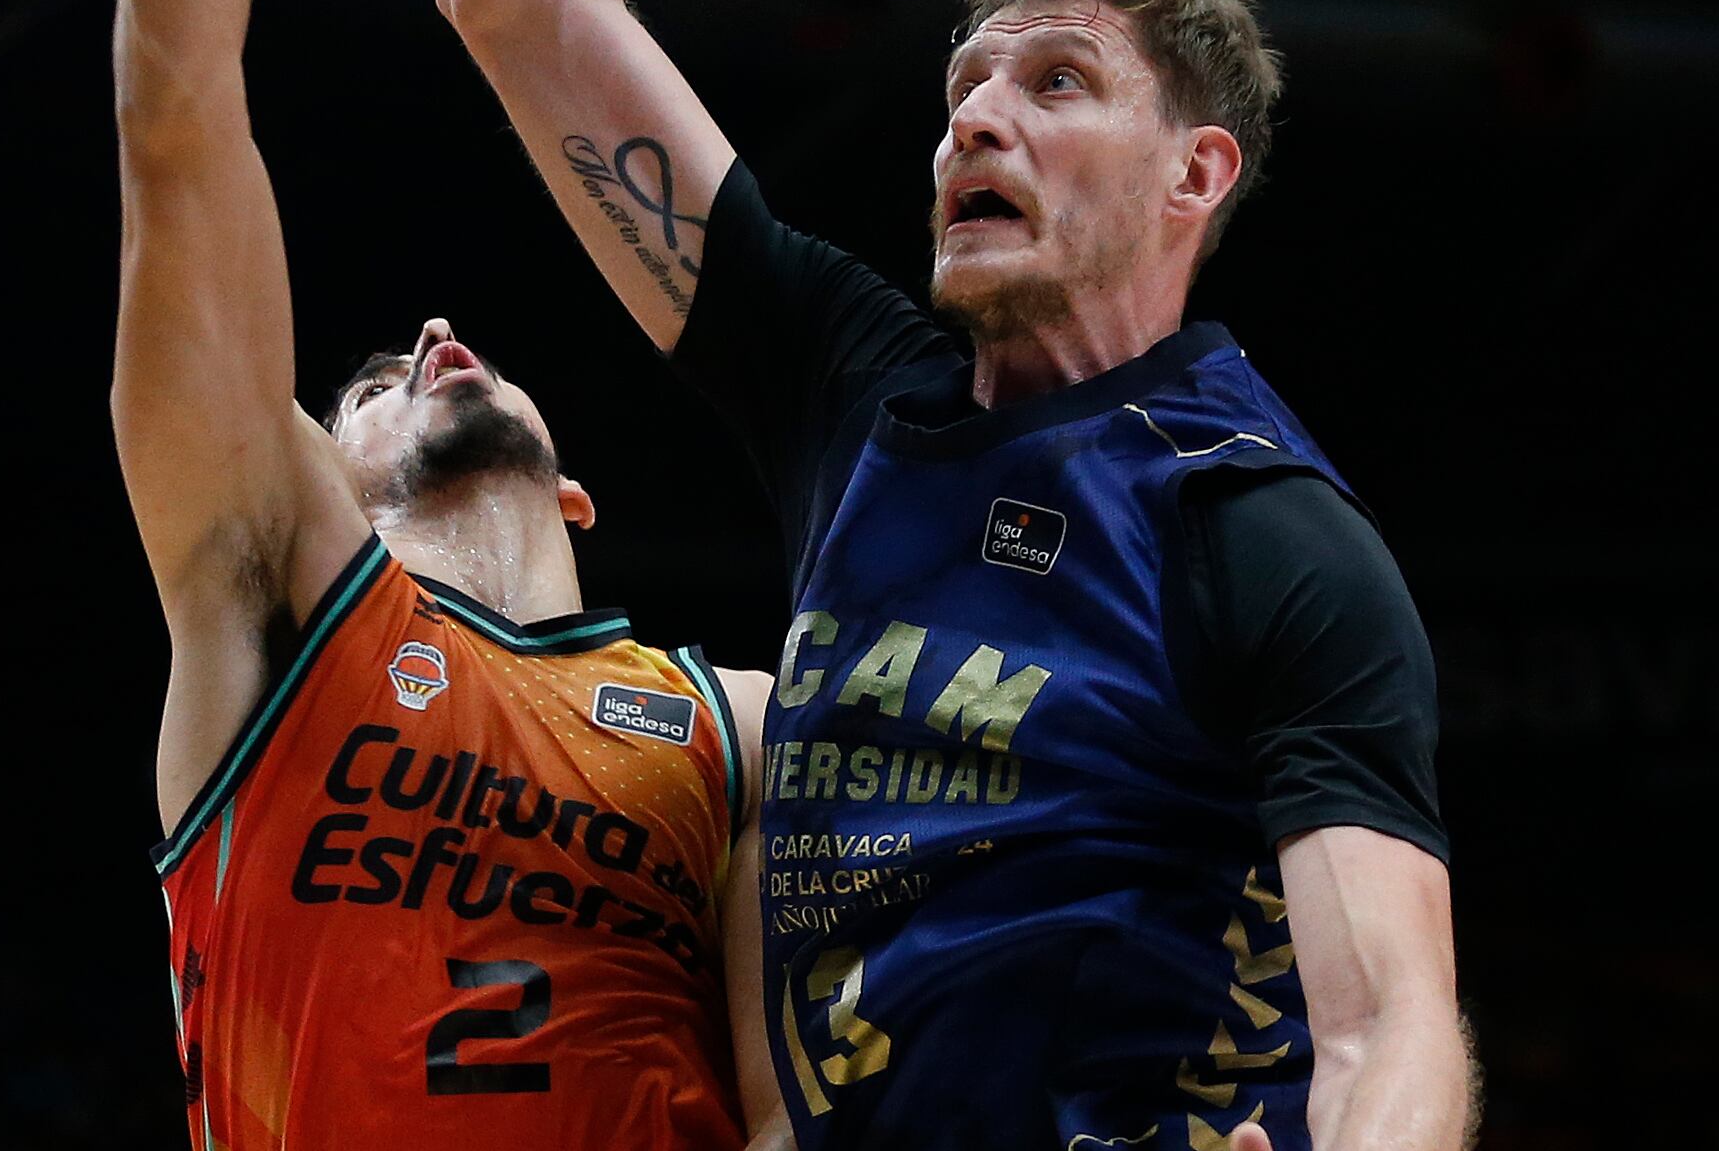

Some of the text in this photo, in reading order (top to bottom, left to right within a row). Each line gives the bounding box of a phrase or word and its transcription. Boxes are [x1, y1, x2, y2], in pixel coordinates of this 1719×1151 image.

[994, 519, 1024, 540] liga
[991, 539, 1051, 565] endesa
[776, 609, 1053, 753] CAM
[604, 697, 643, 715] liga
[602, 711, 685, 738] endesa
[323, 721, 651, 875] Cultura
[770, 832, 912, 861] CARAVACA
[770, 870, 793, 897] DE
[798, 869, 827, 896] LA
[770, 904, 820, 936] AÑO
[425, 958, 552, 1097] 2
[782, 944, 893, 1118] 13
